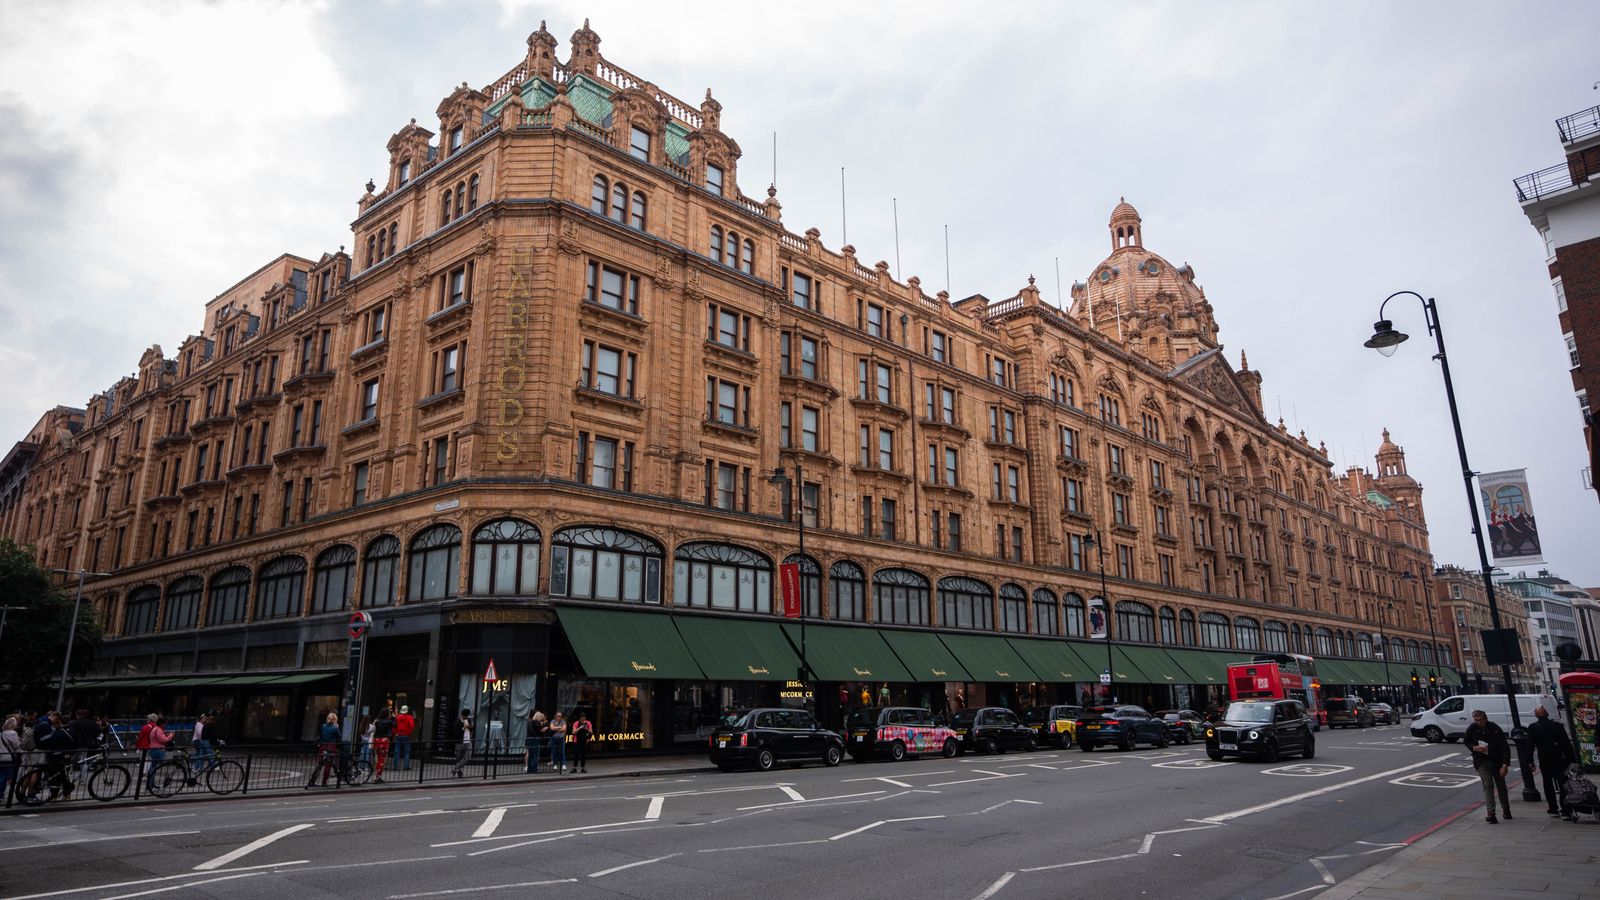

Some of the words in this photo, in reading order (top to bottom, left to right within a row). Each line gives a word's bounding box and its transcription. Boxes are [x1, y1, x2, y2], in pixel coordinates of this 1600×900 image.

[497, 244, 533, 462] HARRODS
[786, 680, 807, 688] JESSIC
[607, 732, 645, 741] CORMACK
